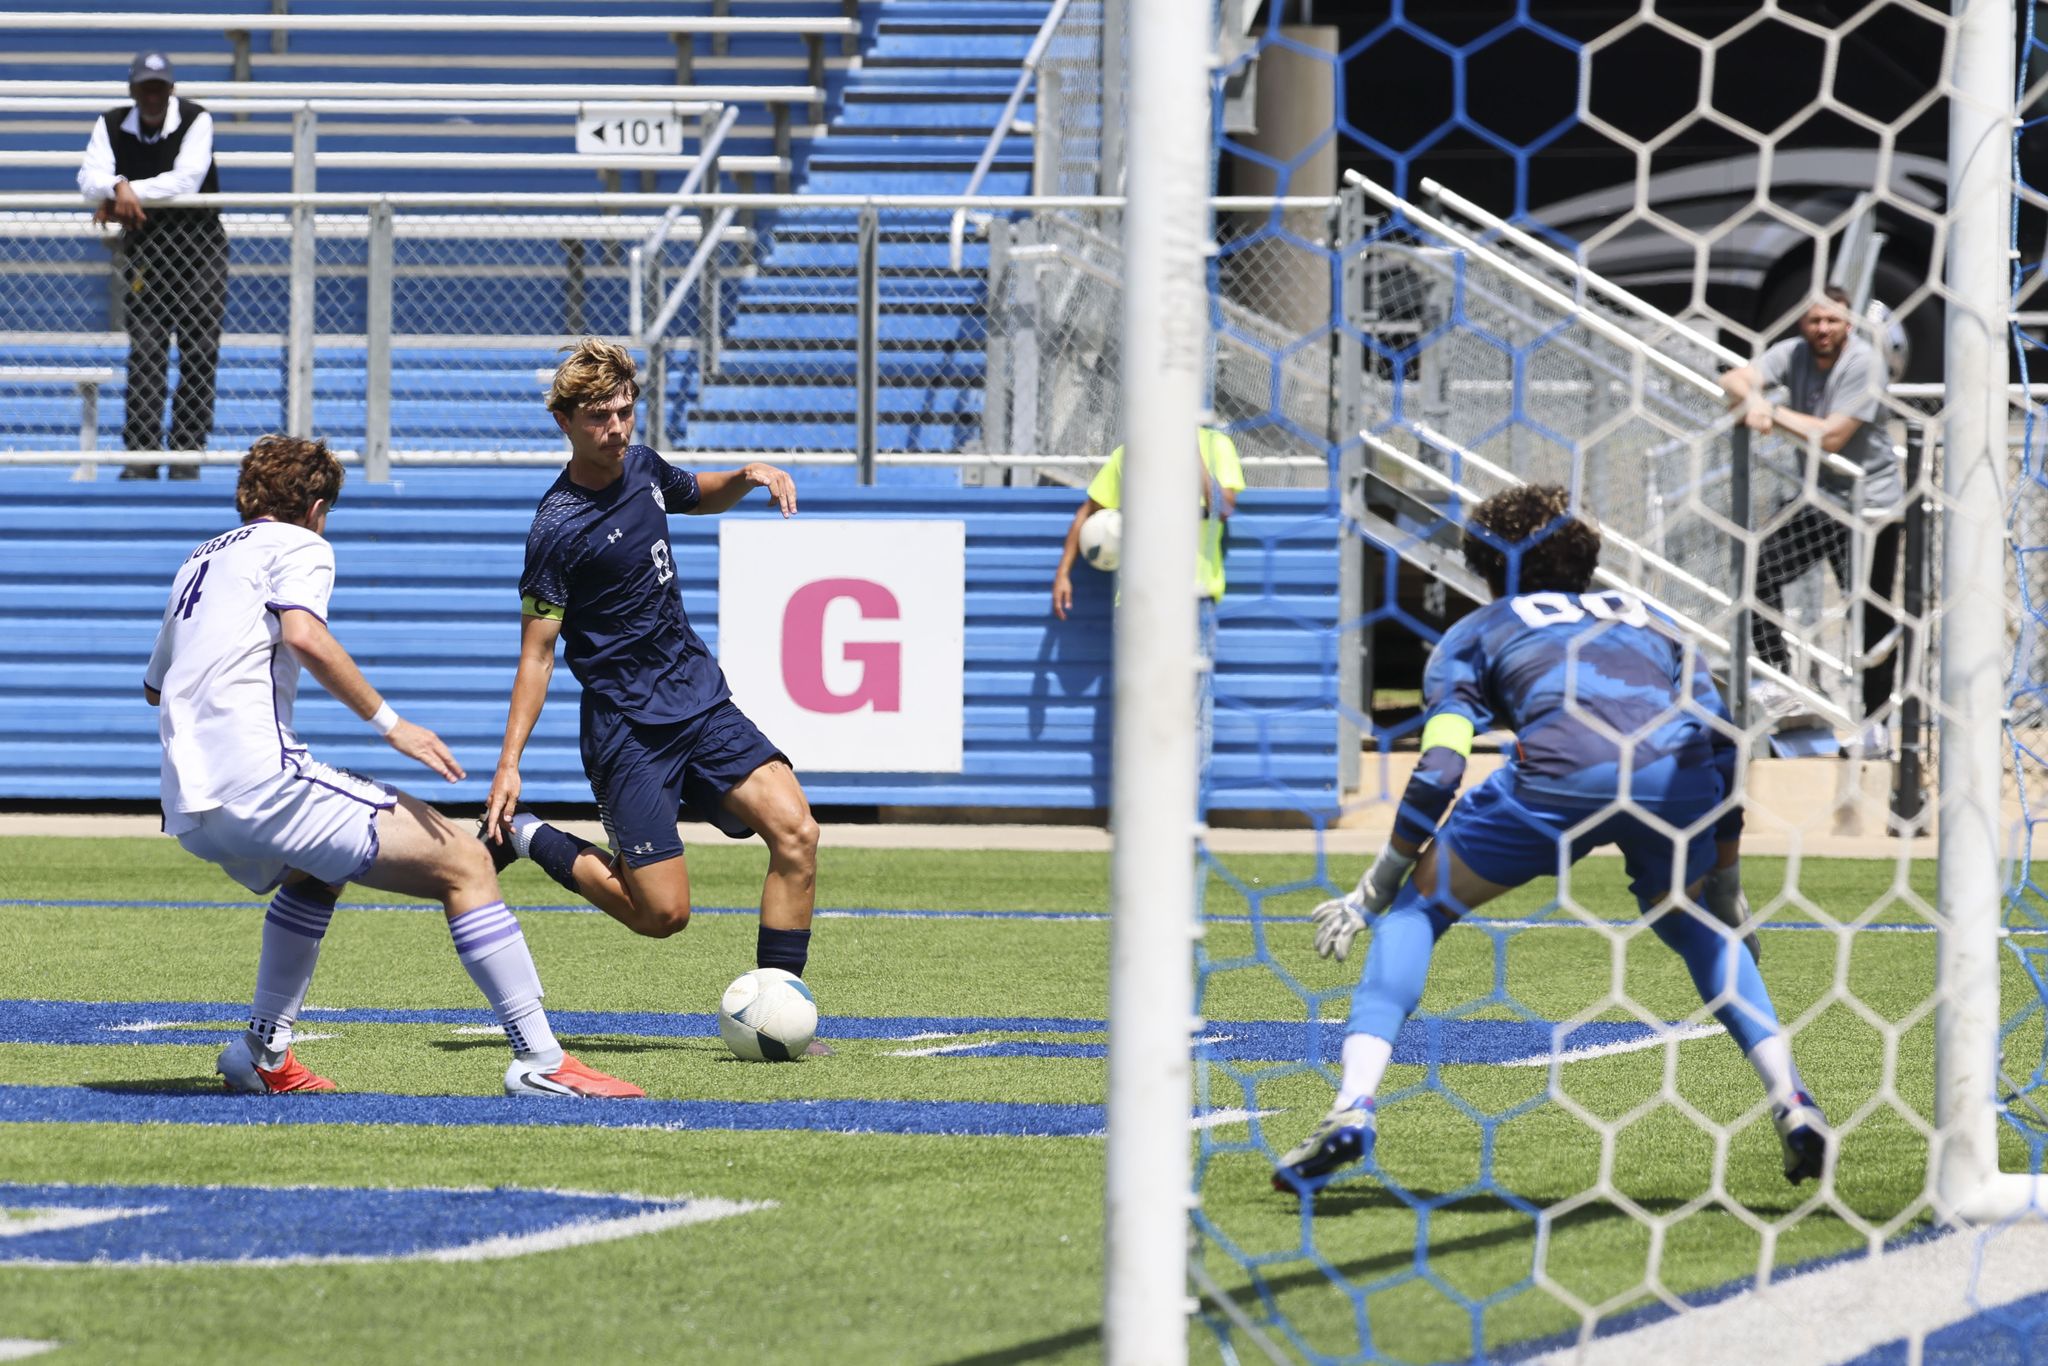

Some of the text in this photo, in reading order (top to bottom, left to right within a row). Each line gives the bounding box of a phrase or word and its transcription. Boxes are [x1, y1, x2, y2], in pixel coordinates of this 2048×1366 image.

[615, 119, 664, 146] 101
[173, 558, 211, 621] 4
[534, 599, 552, 616] C
[781, 577, 901, 715] G
